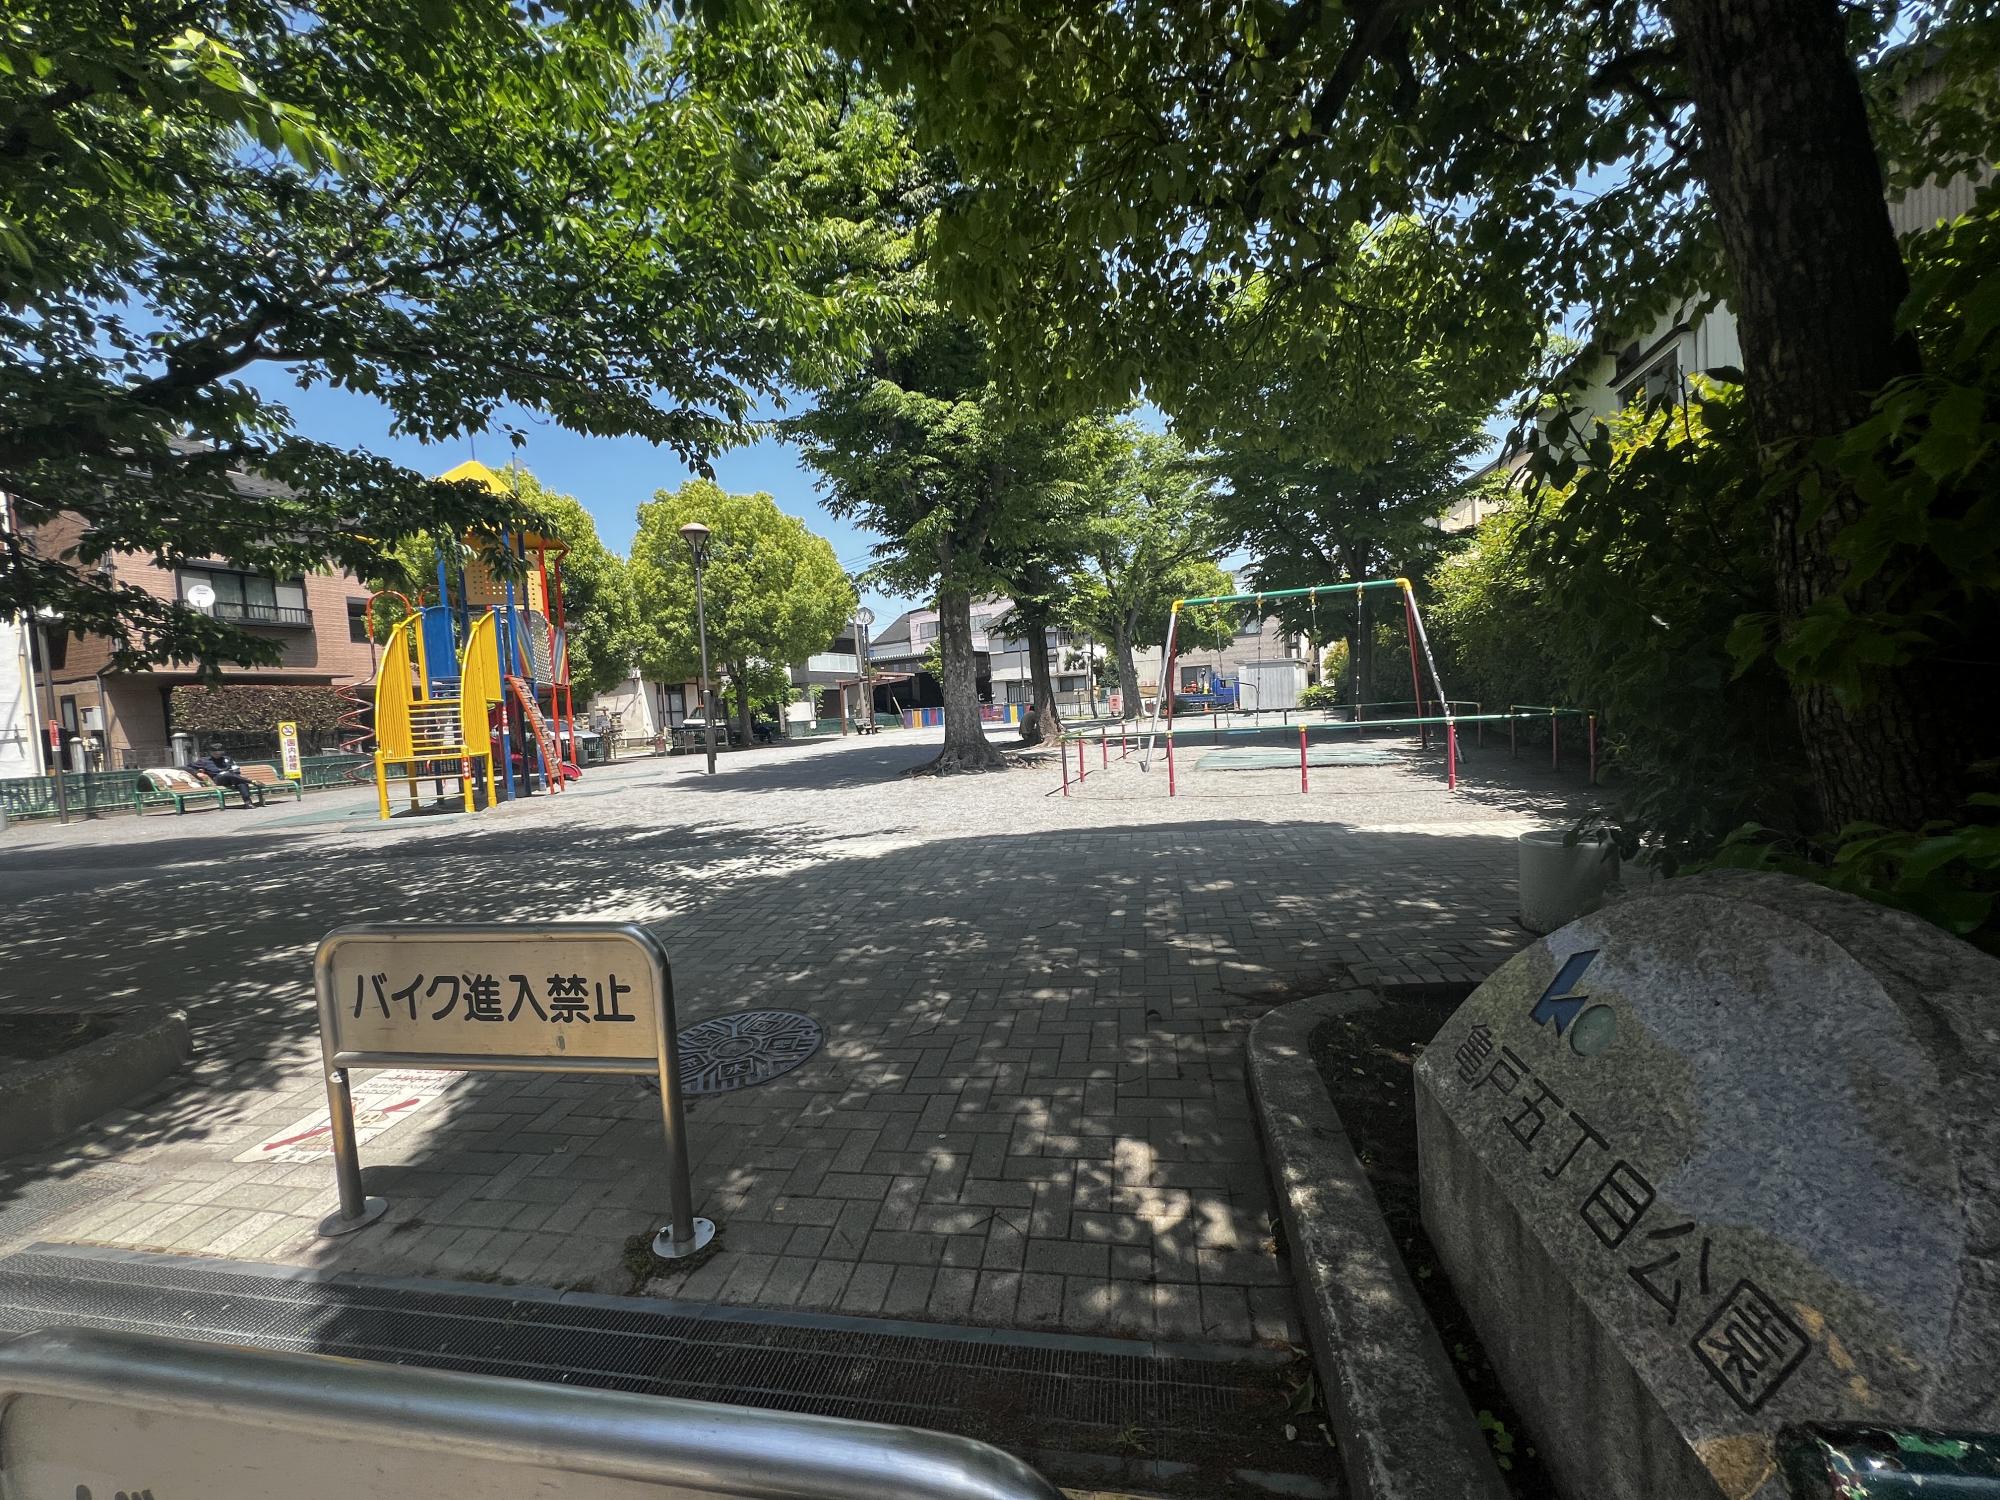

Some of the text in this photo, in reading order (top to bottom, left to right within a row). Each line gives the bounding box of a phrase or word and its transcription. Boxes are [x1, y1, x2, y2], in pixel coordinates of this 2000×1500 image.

[353, 973, 637, 1024] バイク進入禁止
[1454, 1022, 1812, 1416] 亀戸五丁目公園
